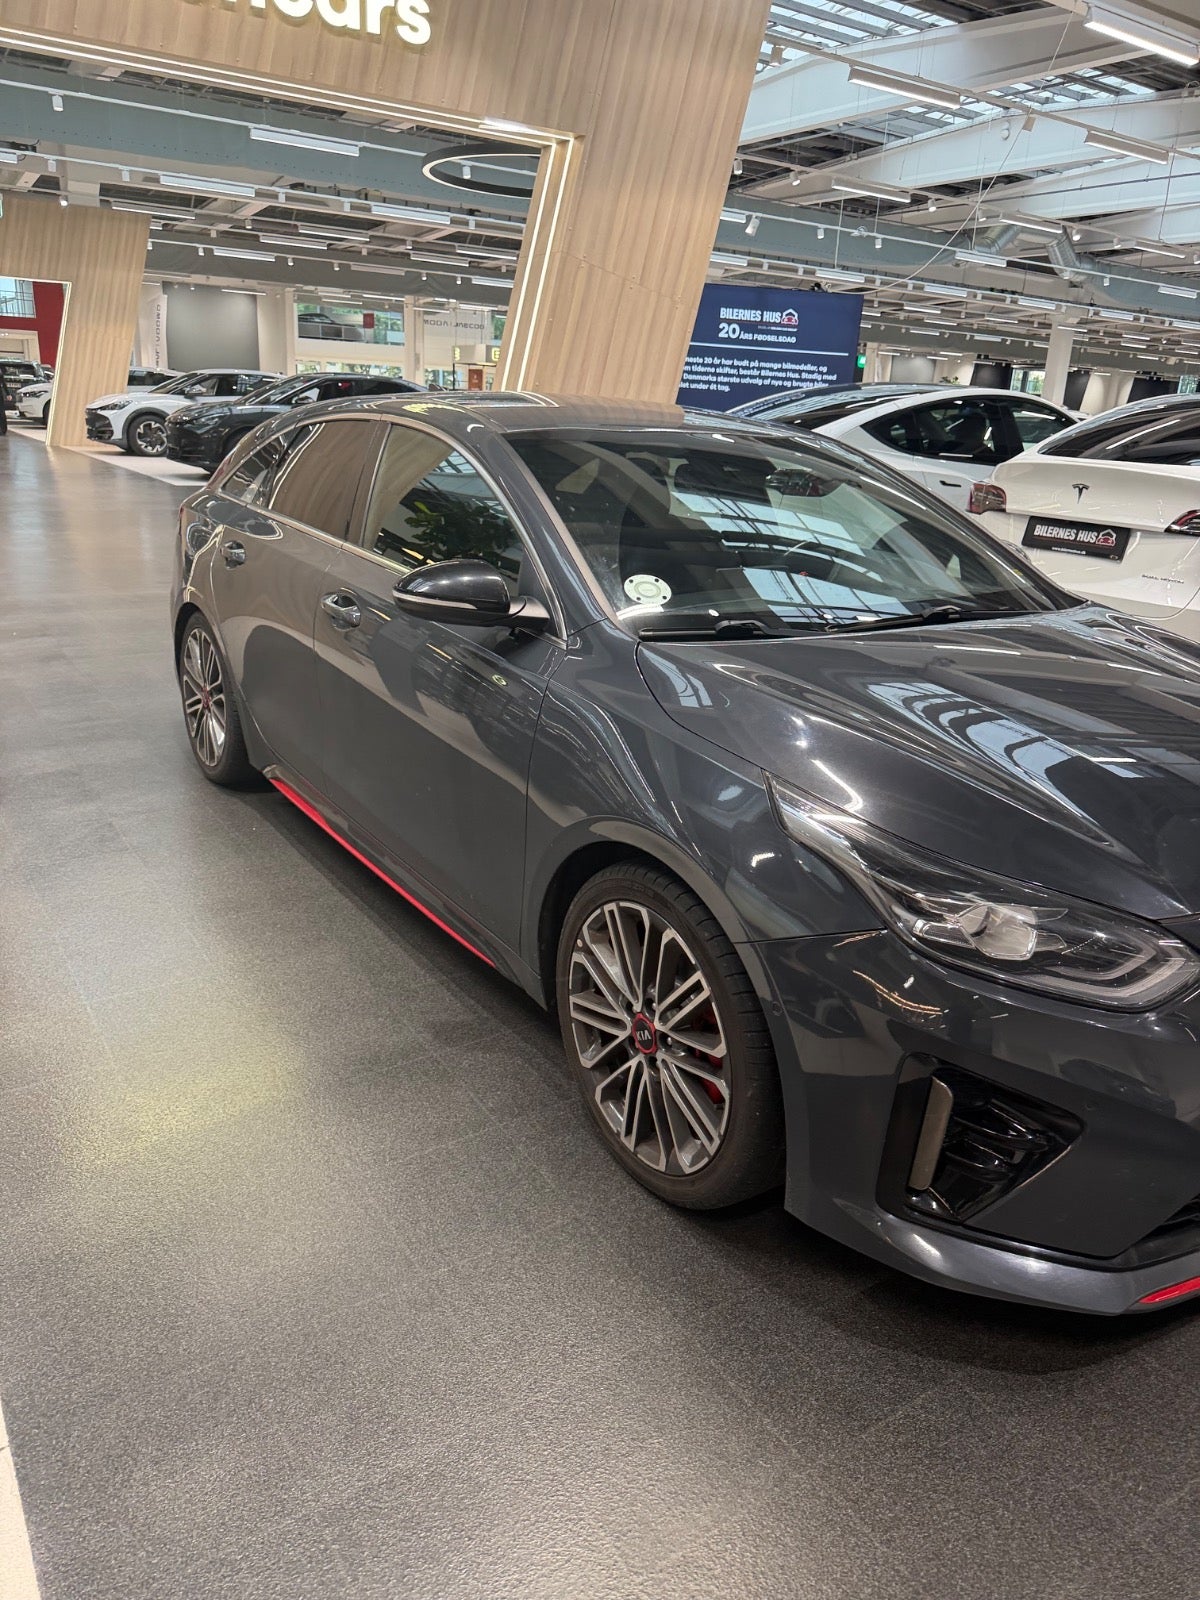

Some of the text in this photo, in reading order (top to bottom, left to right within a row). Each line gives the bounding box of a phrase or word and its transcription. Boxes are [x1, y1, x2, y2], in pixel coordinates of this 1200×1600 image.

[720, 307, 782, 323] BILERNES HUS
[718, 322, 740, 339] 20
[739, 331, 753, 340] ÅRS
[685, 356, 703, 364] neste
[713, 357, 721, 365] år
[734, 358, 749, 366] budt
[750, 360, 759, 368] på
[760, 362, 781, 370] mange
[782, 362, 818, 372] bilmodeller,
[692, 364, 715, 373] tiderne
[716, 366, 738, 376] skifter,
[739, 368, 760, 376] består
[761, 370, 786, 378] Bilernes
[787, 371, 800, 379] Hus.
[801, 372, 822, 381] Stadig
[683, 373, 716, 382] Danmarks
[717, 375, 740, 383] største
[740, 377, 762, 386] udvalg
[793, 380, 813, 389] brugte
[690, 382, 709, 390] under
[710, 383, 717, 391] ét
[717, 384, 730, 392] tag.
[1033, 524, 1098, 543] BILERNES HUS
[636, 1029, 652, 1041] KIA
